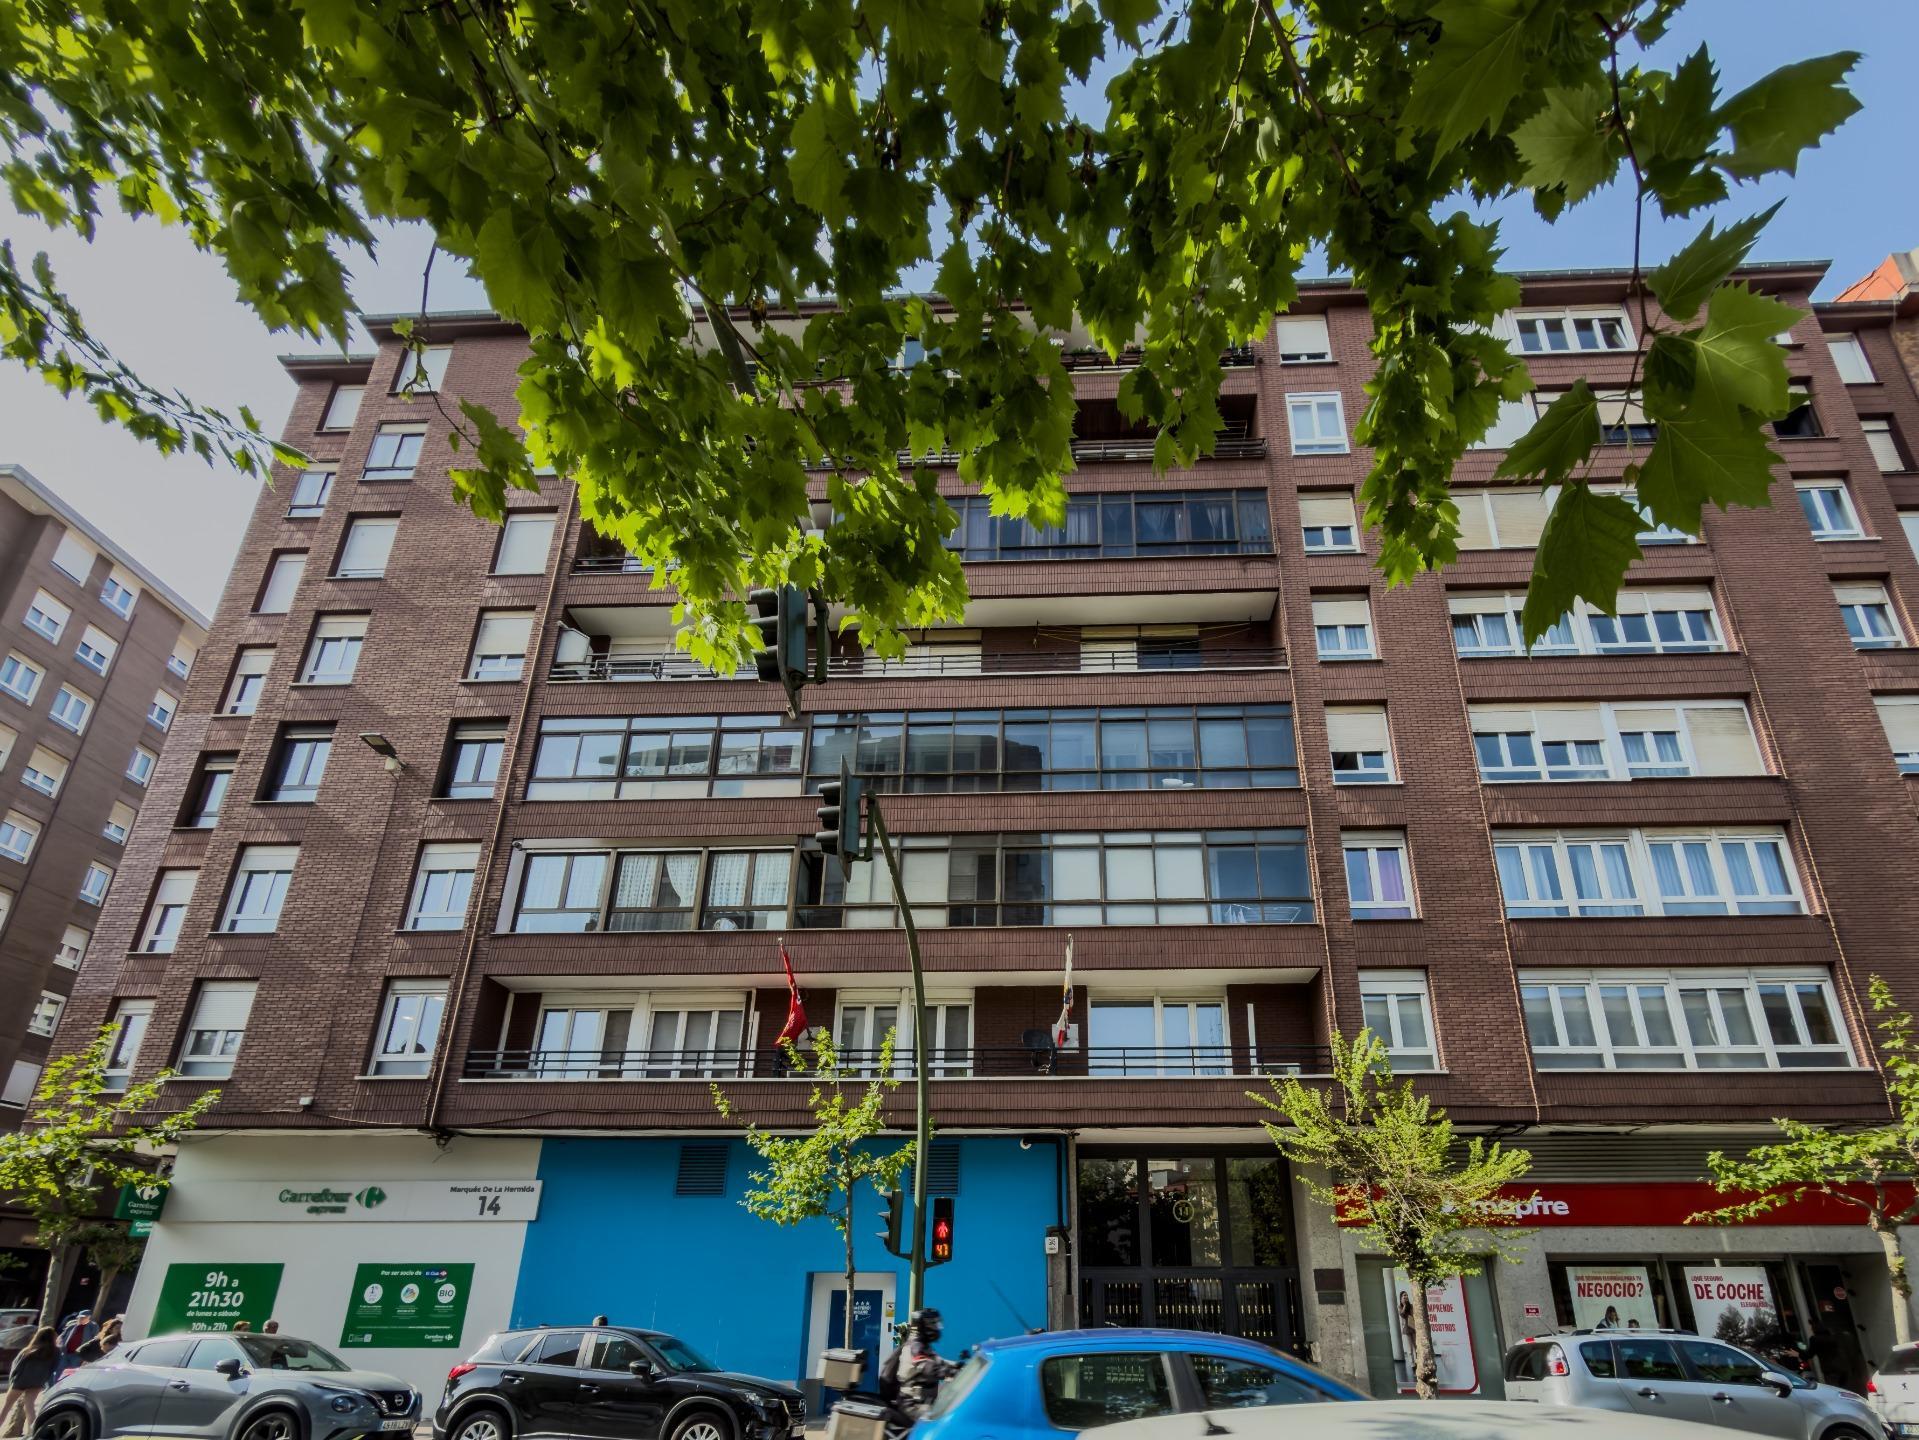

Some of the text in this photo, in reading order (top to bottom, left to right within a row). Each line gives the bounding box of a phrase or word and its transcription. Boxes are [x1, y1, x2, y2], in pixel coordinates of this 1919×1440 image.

[279, 1188, 352, 1203] Carrefour
[478, 1196, 501, 1215] 14
[936, 1243, 949, 1256] 47
[205, 1271, 239, 1287] 9h a
[1577, 1283, 1644, 1297] NEGOCIO?
[1694, 1284, 1764, 1300] DE COCHE
[188, 1291, 244, 1307] 21h30
[1426, 1304, 1454, 1312] MPRENDE
[191, 1322, 206, 1331] 10h
[212, 1322, 228, 1331] 21h
[1430, 1324, 1456, 1332] OSOTROS
